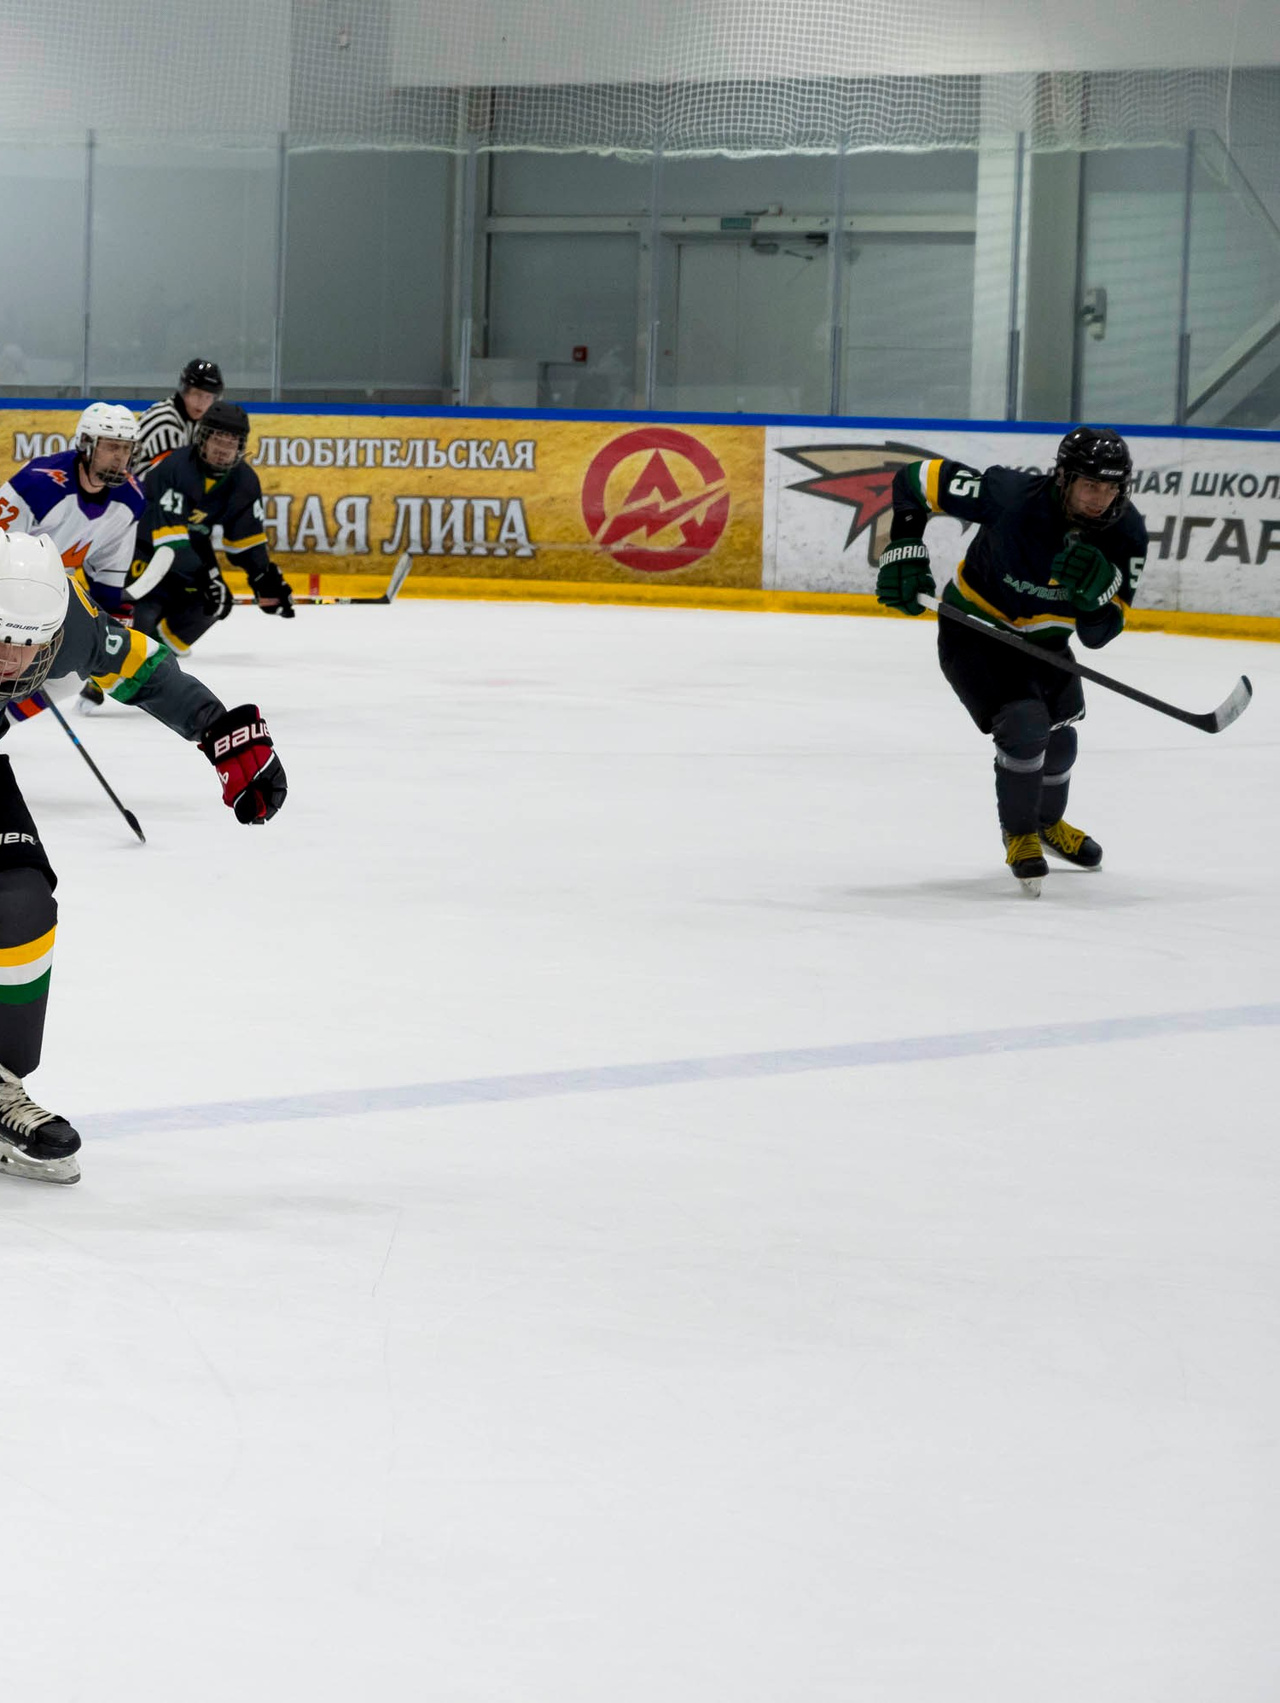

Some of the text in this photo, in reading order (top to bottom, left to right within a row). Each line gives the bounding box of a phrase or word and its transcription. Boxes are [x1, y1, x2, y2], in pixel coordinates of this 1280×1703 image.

[252, 437, 536, 470] ЛЮБИТЕЛЬСКАЯ
[1190, 471, 1280, 499] ШКОЛ
[380, 496, 535, 558] ЛИГА
[5, 622, 40, 631] BAUER
